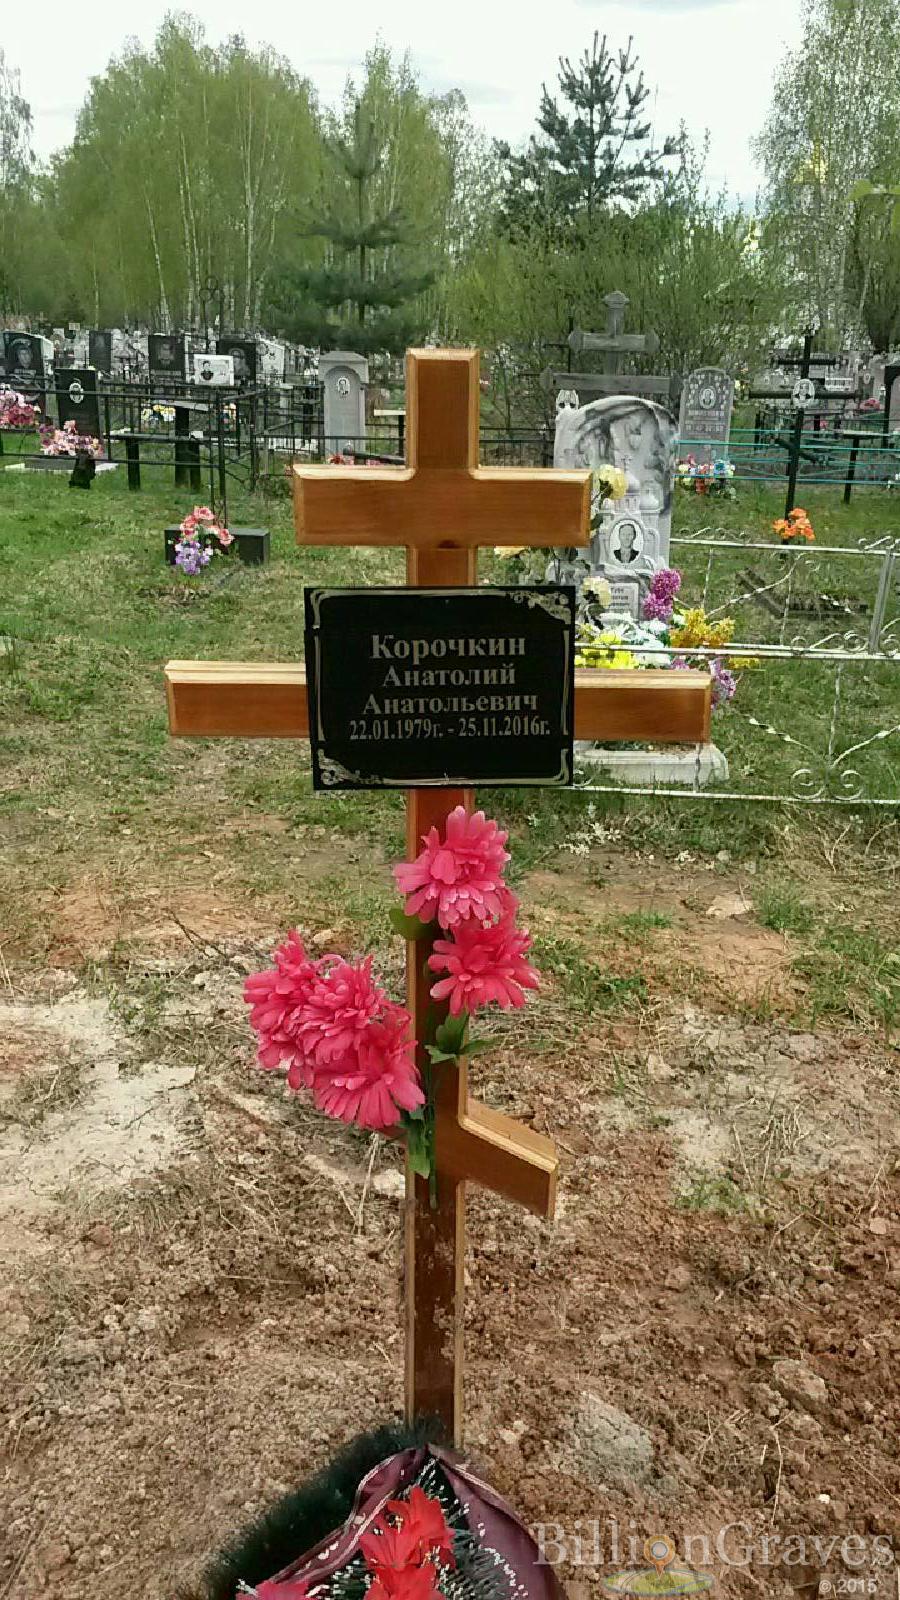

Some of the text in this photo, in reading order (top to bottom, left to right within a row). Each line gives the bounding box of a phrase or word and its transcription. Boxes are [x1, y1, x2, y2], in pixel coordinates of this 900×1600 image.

[369, 634, 526, 665] Корочкин
[383, 663, 516, 687] Анатолий
[362, 693, 539, 716] Анатольевич
[349, 719, 444, 741] 22.01.1979г.
[457, 715, 551, 737] 25.11.2016г.
